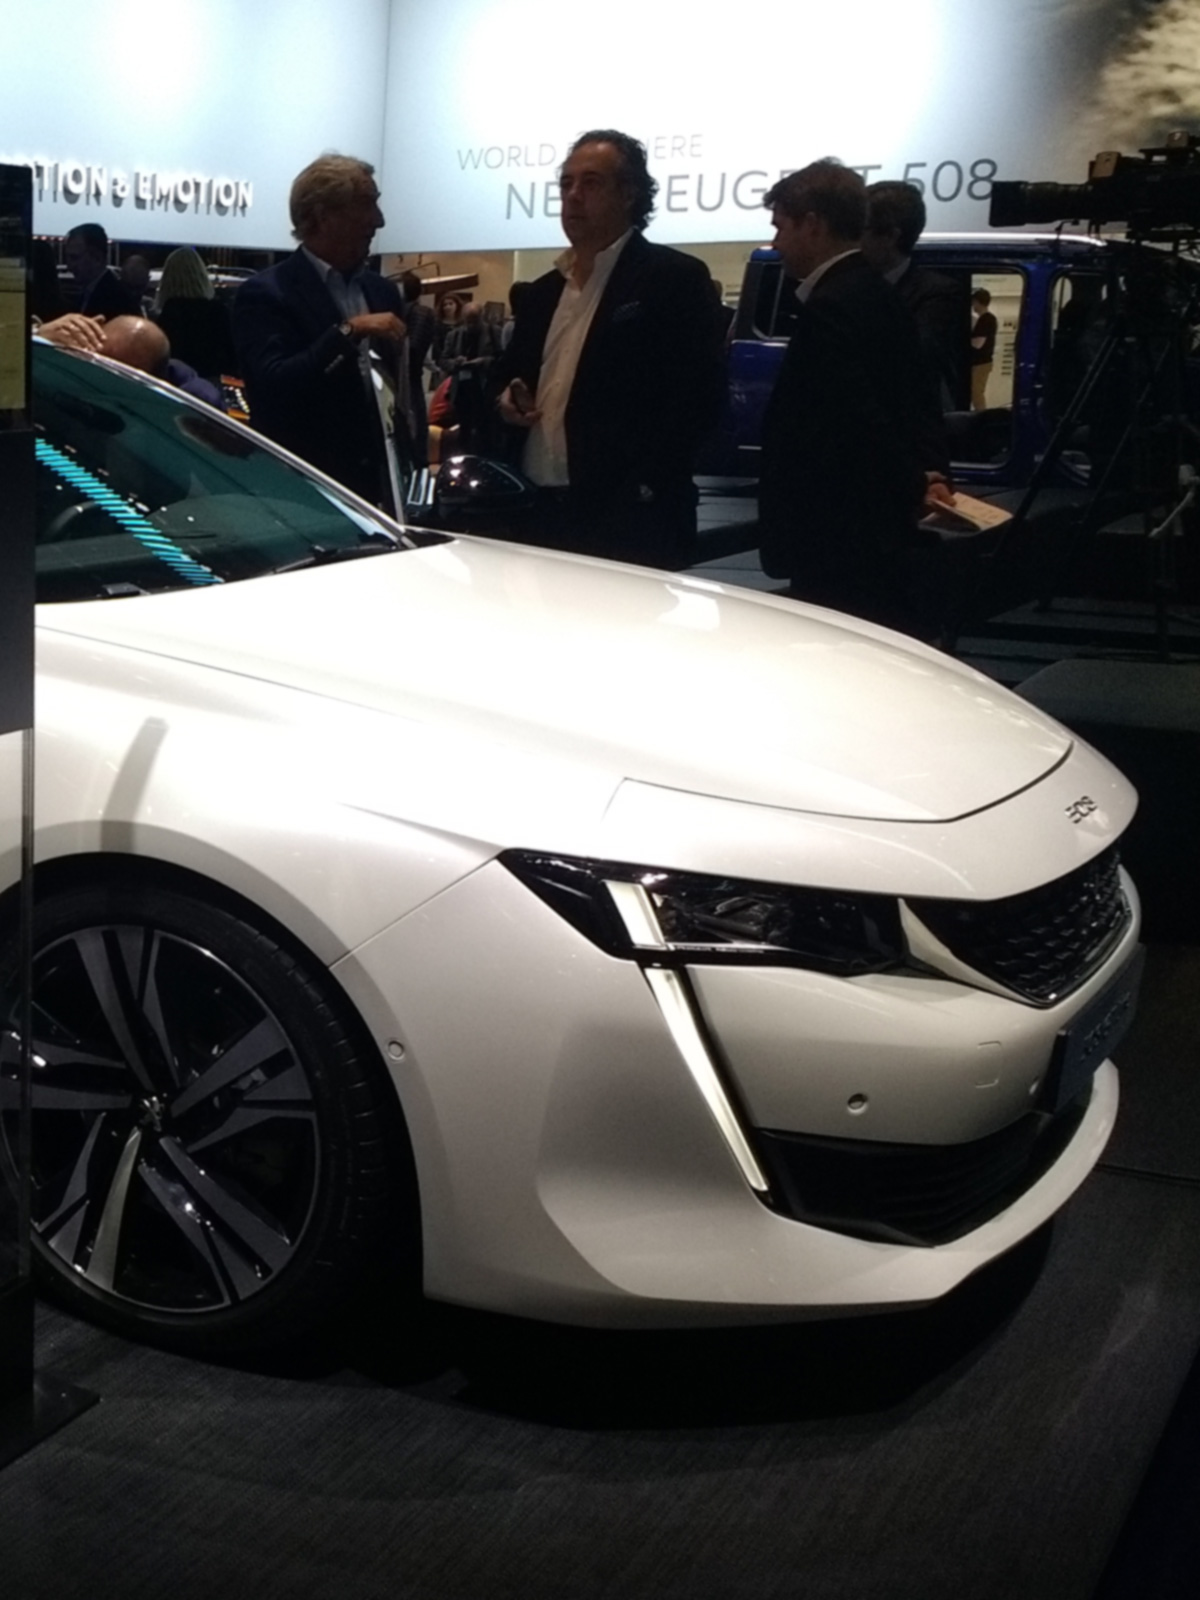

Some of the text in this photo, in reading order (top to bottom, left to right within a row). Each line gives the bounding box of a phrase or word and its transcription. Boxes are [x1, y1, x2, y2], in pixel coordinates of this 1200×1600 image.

[456, 143, 557, 171] WORLD
[111, 172, 131, 208] &
[134, 171, 253, 218] EMOTION
[505, 158, 999, 220] NE EUGT 508
